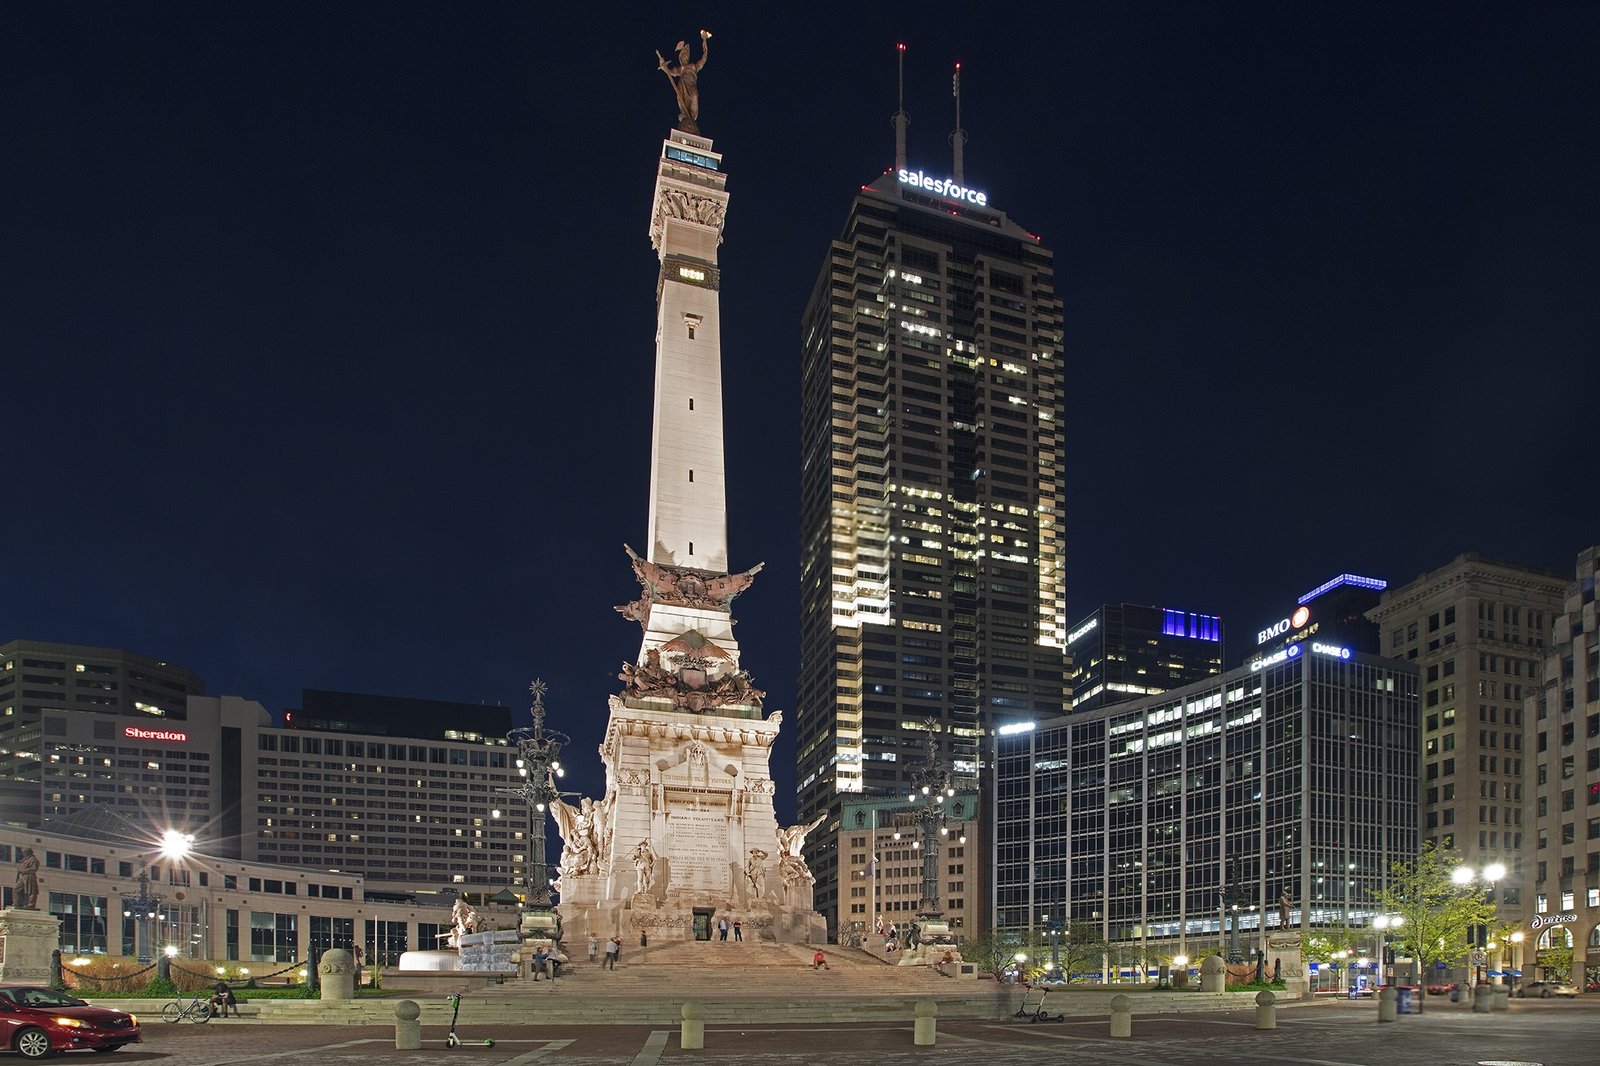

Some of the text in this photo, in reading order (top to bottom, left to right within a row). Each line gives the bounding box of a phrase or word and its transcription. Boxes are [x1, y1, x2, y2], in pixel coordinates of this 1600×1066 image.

[898, 168, 987, 206] salesforce
[1257, 618, 1291, 645] BMO
[1251, 649, 1288, 672] CHASE
[1311, 642, 1342, 657] CHASE
[125, 727, 186, 741] Sheraton
